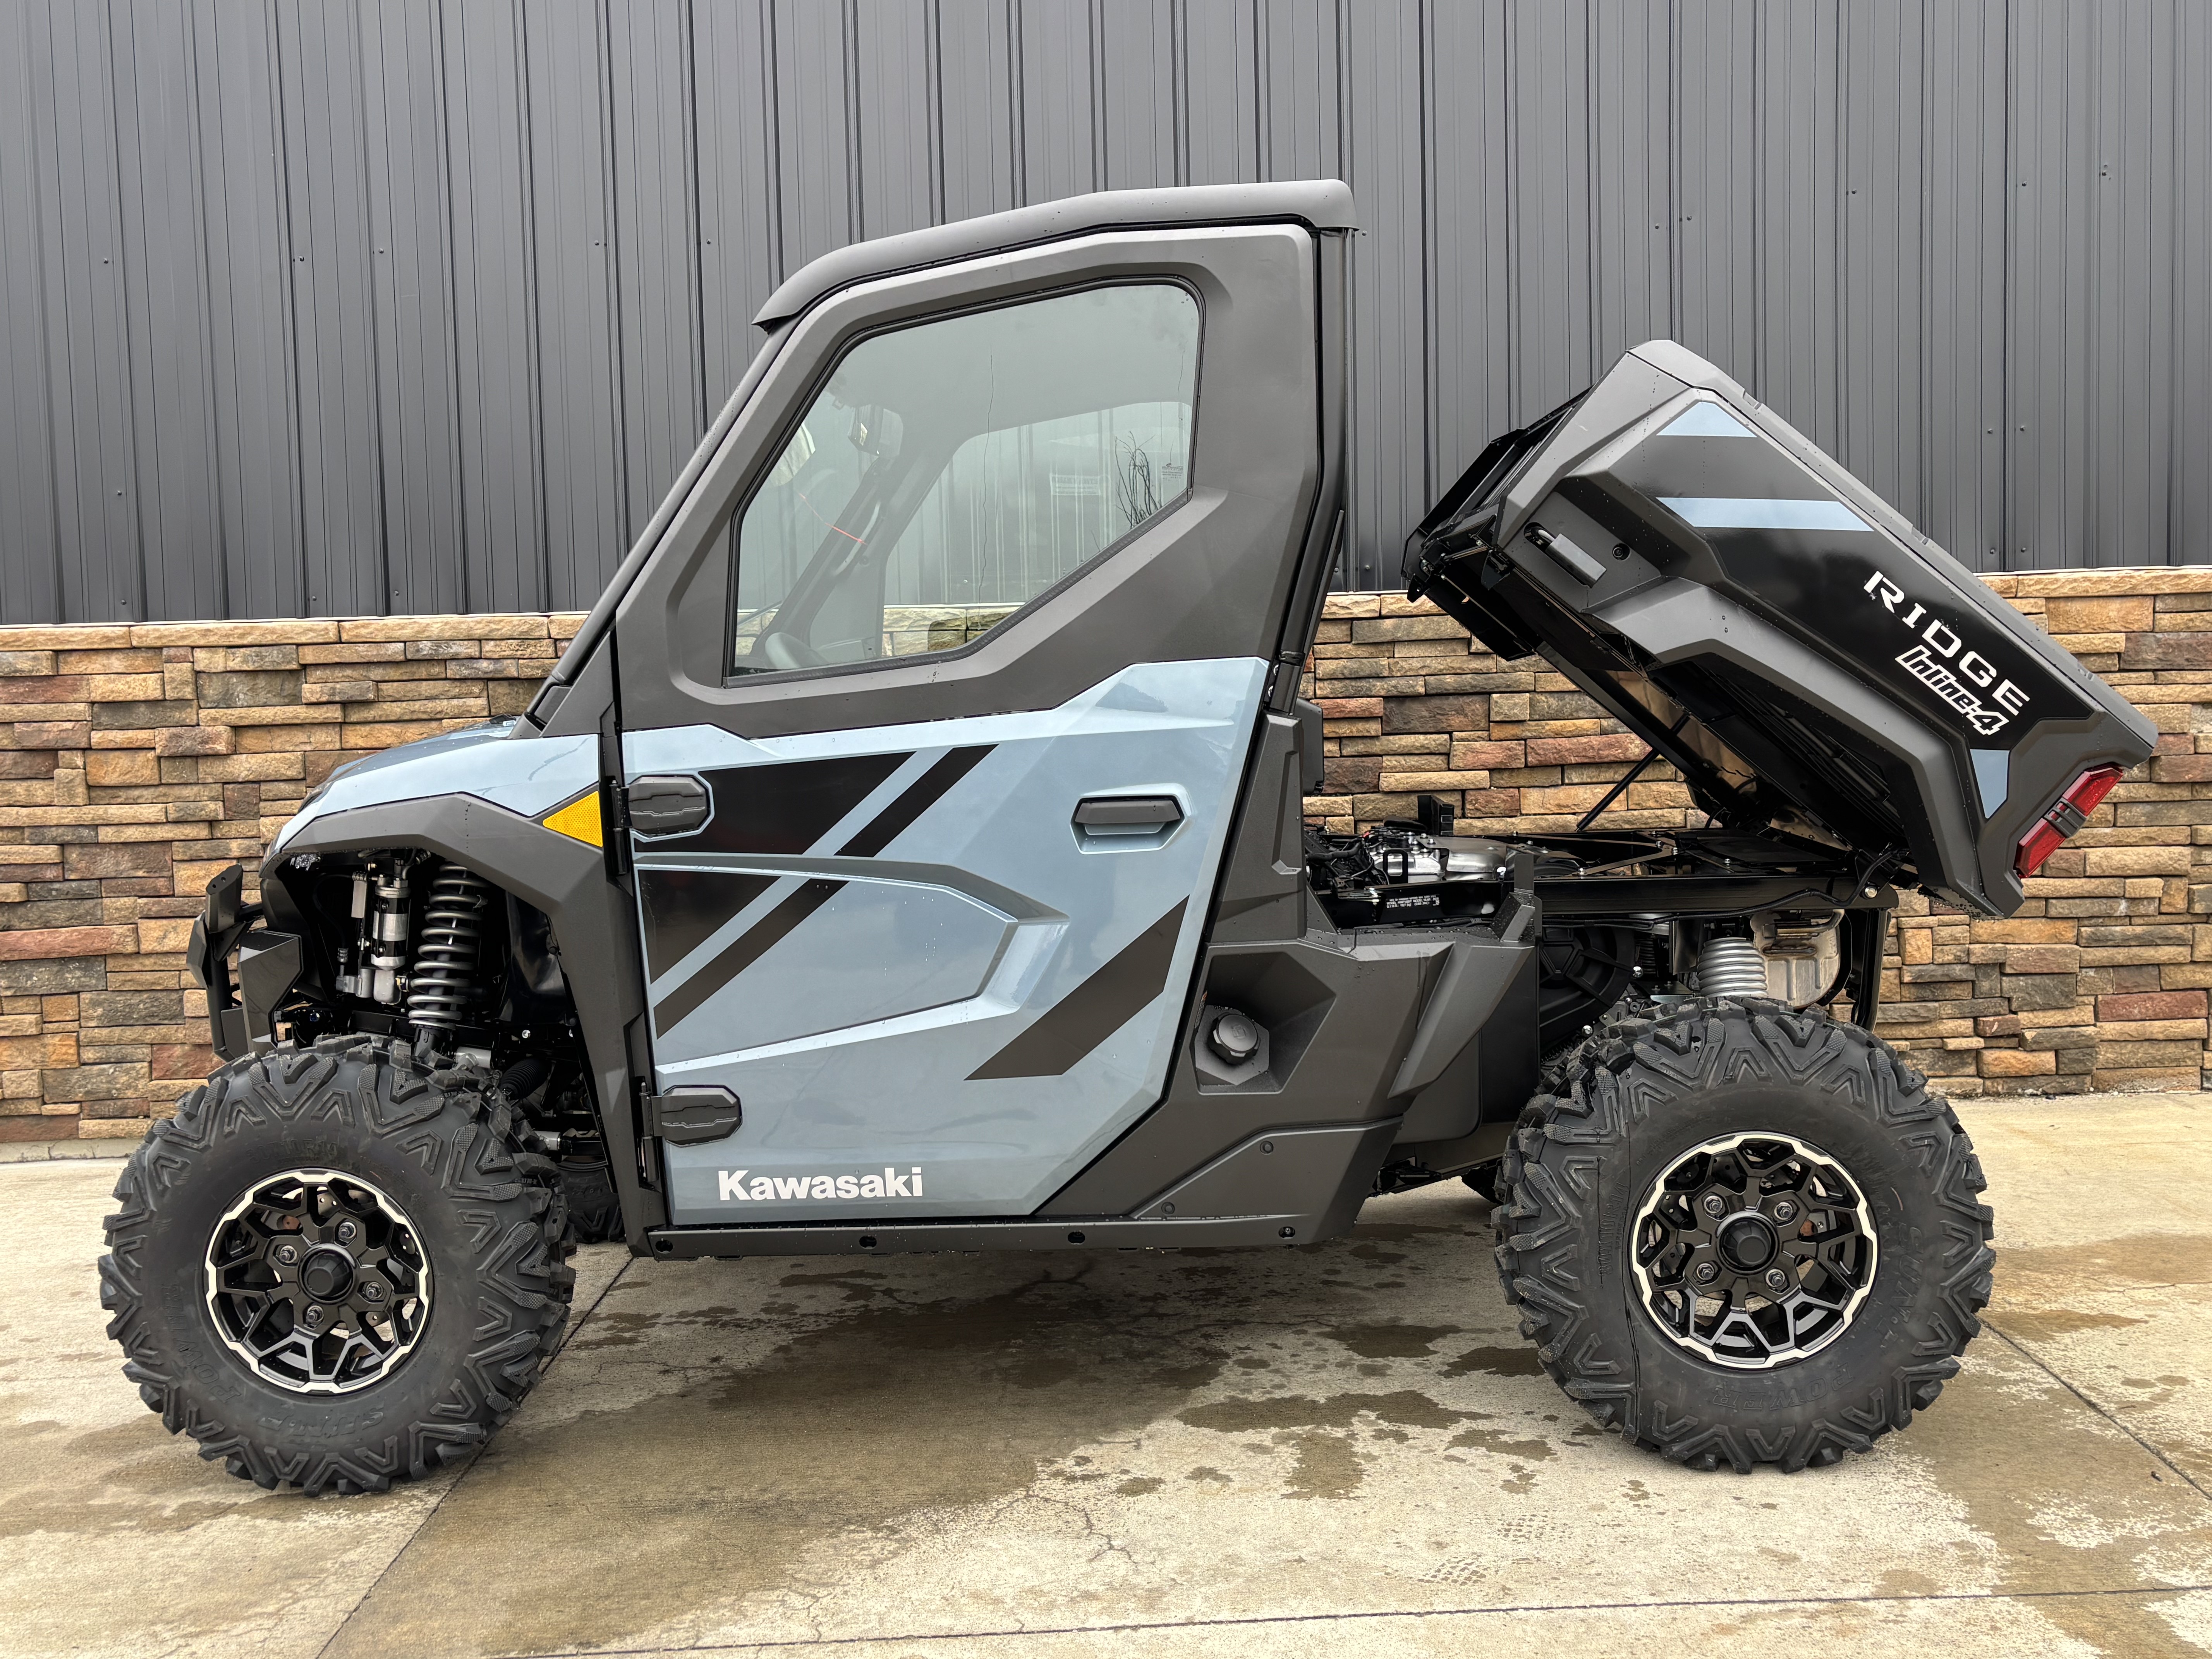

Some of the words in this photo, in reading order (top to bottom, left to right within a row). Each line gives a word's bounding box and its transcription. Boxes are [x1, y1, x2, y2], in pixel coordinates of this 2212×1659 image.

[1863, 571, 2030, 716] RIDGE
[1895, 644, 2009, 735] Inline-4
[718, 1166, 923, 1201] Kawasaki
[1712, 1362, 1854, 1411] POWER
